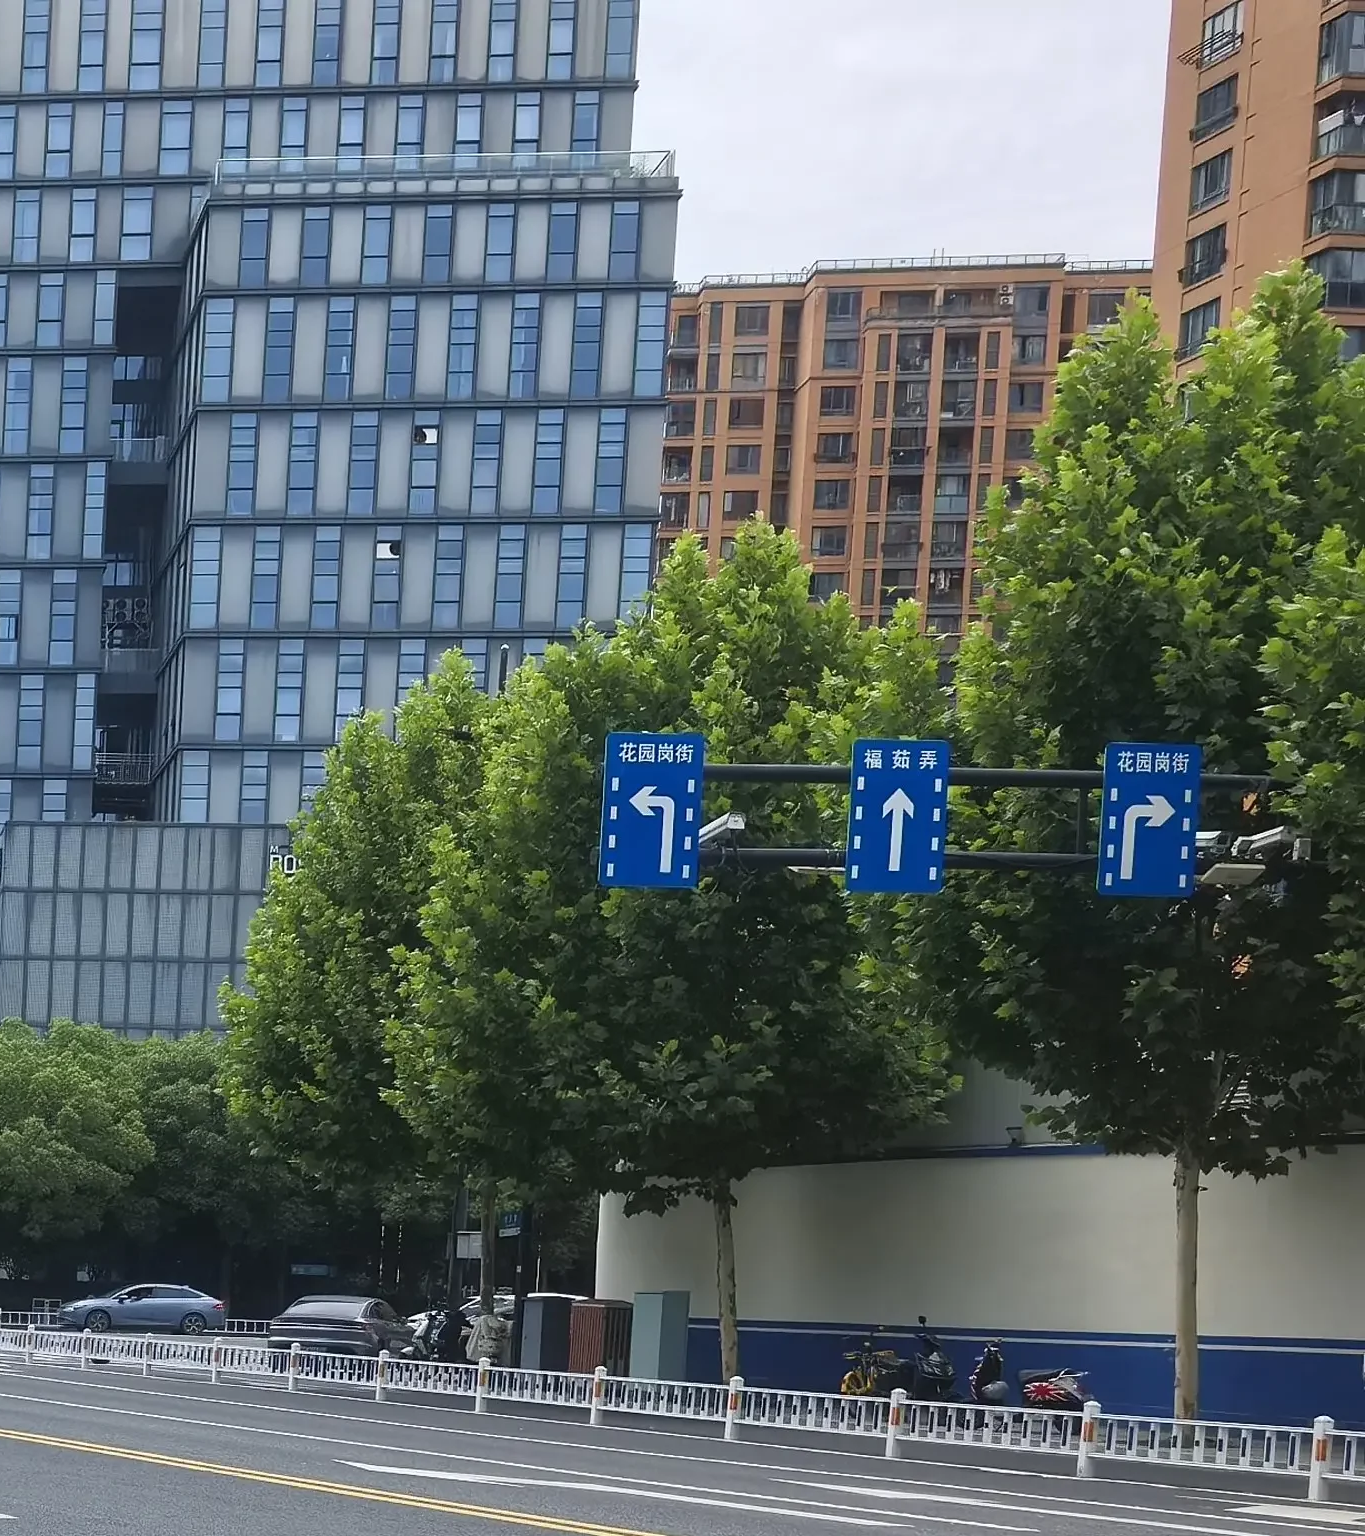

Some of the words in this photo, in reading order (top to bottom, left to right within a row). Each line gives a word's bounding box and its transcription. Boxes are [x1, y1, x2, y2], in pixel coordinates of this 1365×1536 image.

[618, 742, 694, 764] 花园岗街
[864, 748, 938, 770] 福茹弄
[1117, 750, 1190, 773] 花园岗街
